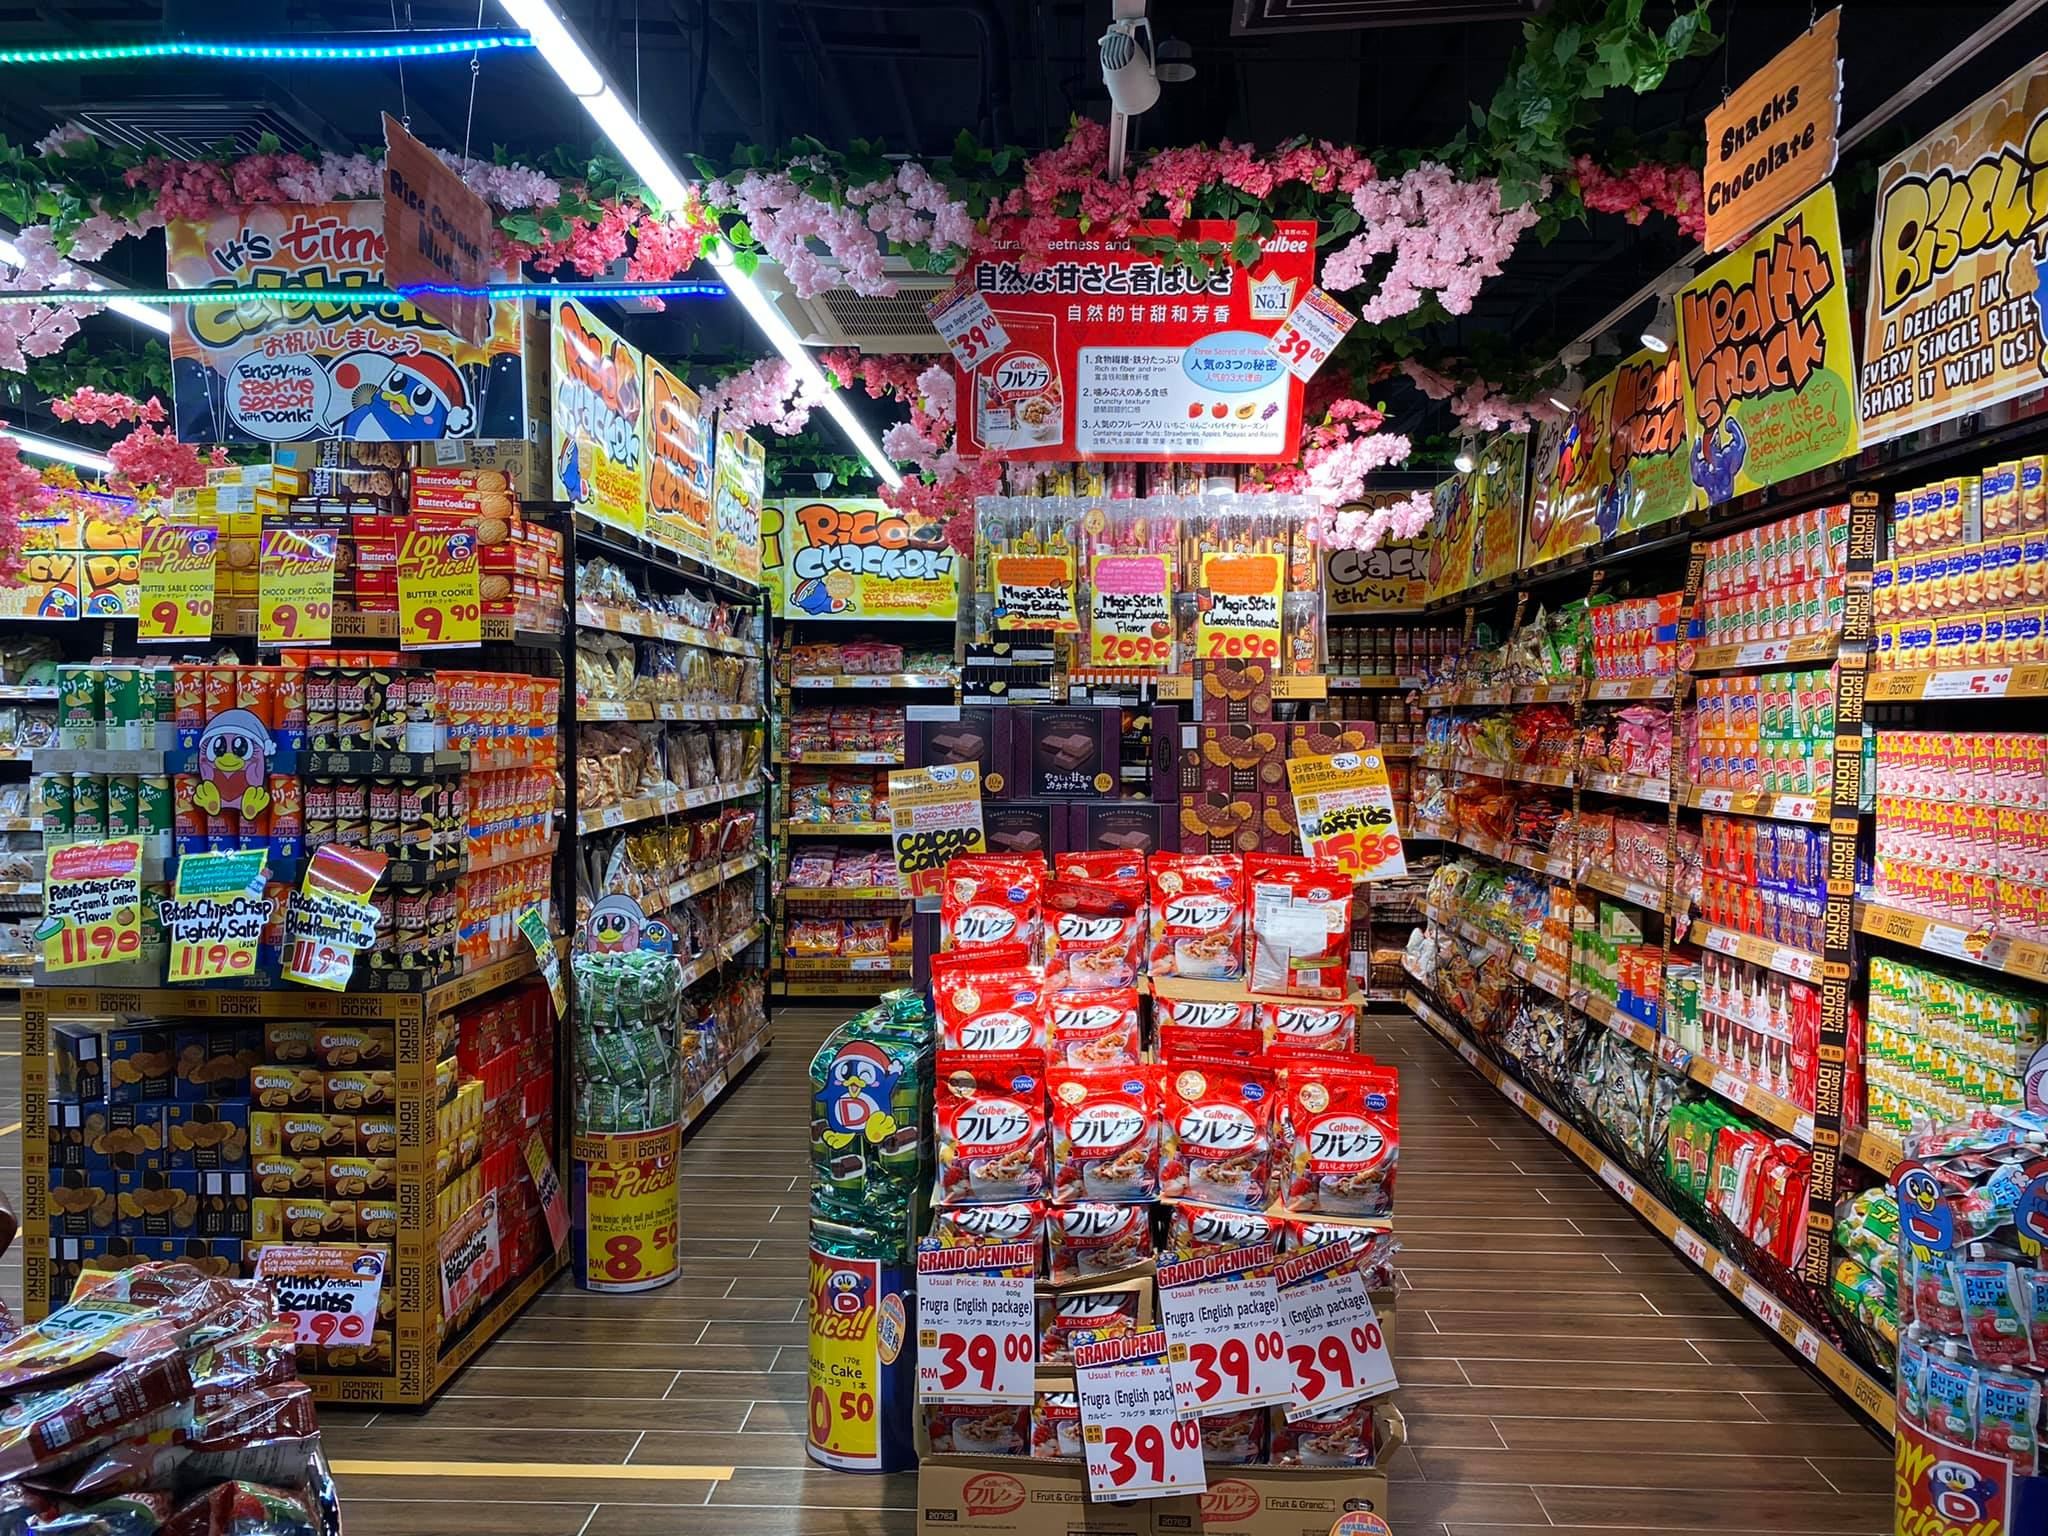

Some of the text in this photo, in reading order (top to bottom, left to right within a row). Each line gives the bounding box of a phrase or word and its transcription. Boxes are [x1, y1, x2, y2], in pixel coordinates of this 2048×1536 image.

[1720, 84, 1800, 162] Snacks
[1706, 121, 1815, 217] Chocolate
[213, 228, 273, 272] It's
[1254, 293, 1288, 309] No.1
[1067, 304, 1231, 323] 自然的甘甜和芳香
[1883, 321, 1896, 352] A
[1010, 360, 1036, 370] Calbee
[1190, 358, 1278, 371] 人気の3つの秘密
[1863, 345, 1912, 393] EVERY
[999, 370, 1049, 388] フルグラ
[1863, 376, 1913, 420] SHARE
[1850, 515, 1866, 559] DONKI
[141, 584, 214, 592] BUTTER SABLE COOKIE
[262, 588, 290, 596] CHOCO
[406, 588, 474, 598] BUTTER COOKIE
[1844, 595, 1860, 640] DONKI
[1825, 904, 1841, 950] DONKI
[100, 1002, 141, 1012] DONKI
[219, 1003, 262, 1015] DONKI
[1822, 986, 1835, 1032] DONKI
[321, 1035, 362, 1048] CRUNKY
[255, 1076, 294, 1089] CRUNKY
[977, 1105, 1007, 1115] Calbee
[1090, 1110, 1120, 1119] Calbee
[1203, 1109, 1234, 1120] Calbee
[957, 1116, 1030, 1141] フルグラ
[1180, 1117, 1256, 1145] フルグラ
[1310, 1131, 1383, 1158] フルグラ
[1811, 1152, 1825, 1199] DONKI
[919, 1249, 966, 1273] GRAND
[1806, 1235, 1821, 1284] DONKI
[1158, 1258, 1206, 1288] GRAND
[956, 1279, 979, 1287] Price:
[1000, 1280, 1024, 1288] 44.50
[1171, 1280, 1267, 1299] Usual Price: RM 44.50
[1311, 1284, 1326, 1293] RM
[1328, 1277, 1352, 1289] 44.50
[920, 1298, 1033, 1317] Frugra (English package)
[1165, 1298, 1280, 1328] Frugra (English package)
[1289, 1292, 1369, 1327] (English package)
[831, 1364, 862, 1379] Cake
[921, 1368, 938, 1378] RM
[1088, 1371, 1111, 1380] Usual
[1115, 1370, 1138, 1378] Price:
[342, 1390, 383, 1400] DONKI
[1176, 1382, 1193, 1395] RM
[1081, 1392, 1110, 1409] Frugra
[1114, 1389, 1149, 1406] (English
[1090, 1464, 1108, 1476] RM
